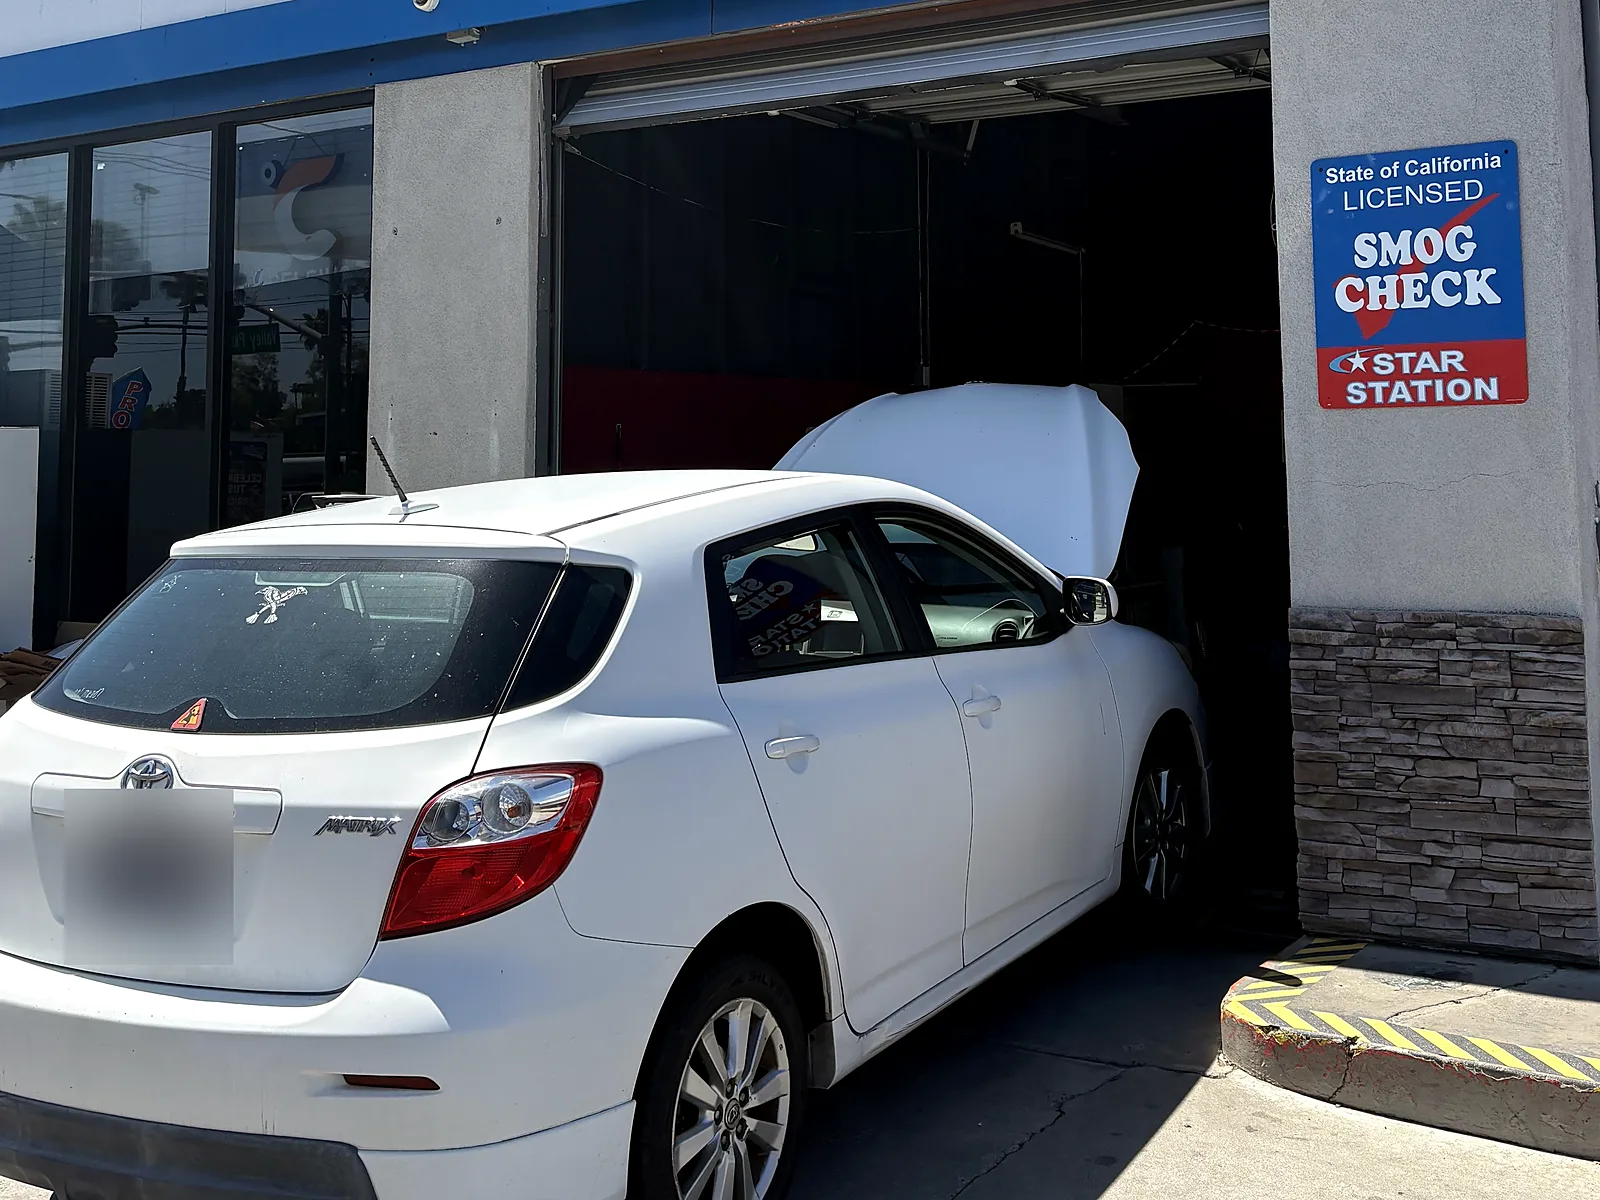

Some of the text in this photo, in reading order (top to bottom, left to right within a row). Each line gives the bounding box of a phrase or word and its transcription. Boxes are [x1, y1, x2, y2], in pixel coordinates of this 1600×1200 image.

[1325, 152, 1502, 184] State of California
[1343, 179, 1484, 211] LICENSED
[1353, 225, 1478, 269] SMOG
[1334, 268, 1502, 313] CHECK
[1371, 349, 1468, 376] STAR
[1345, 376, 1500, 405] STATION
[313, 815, 402, 837] MATRIX
